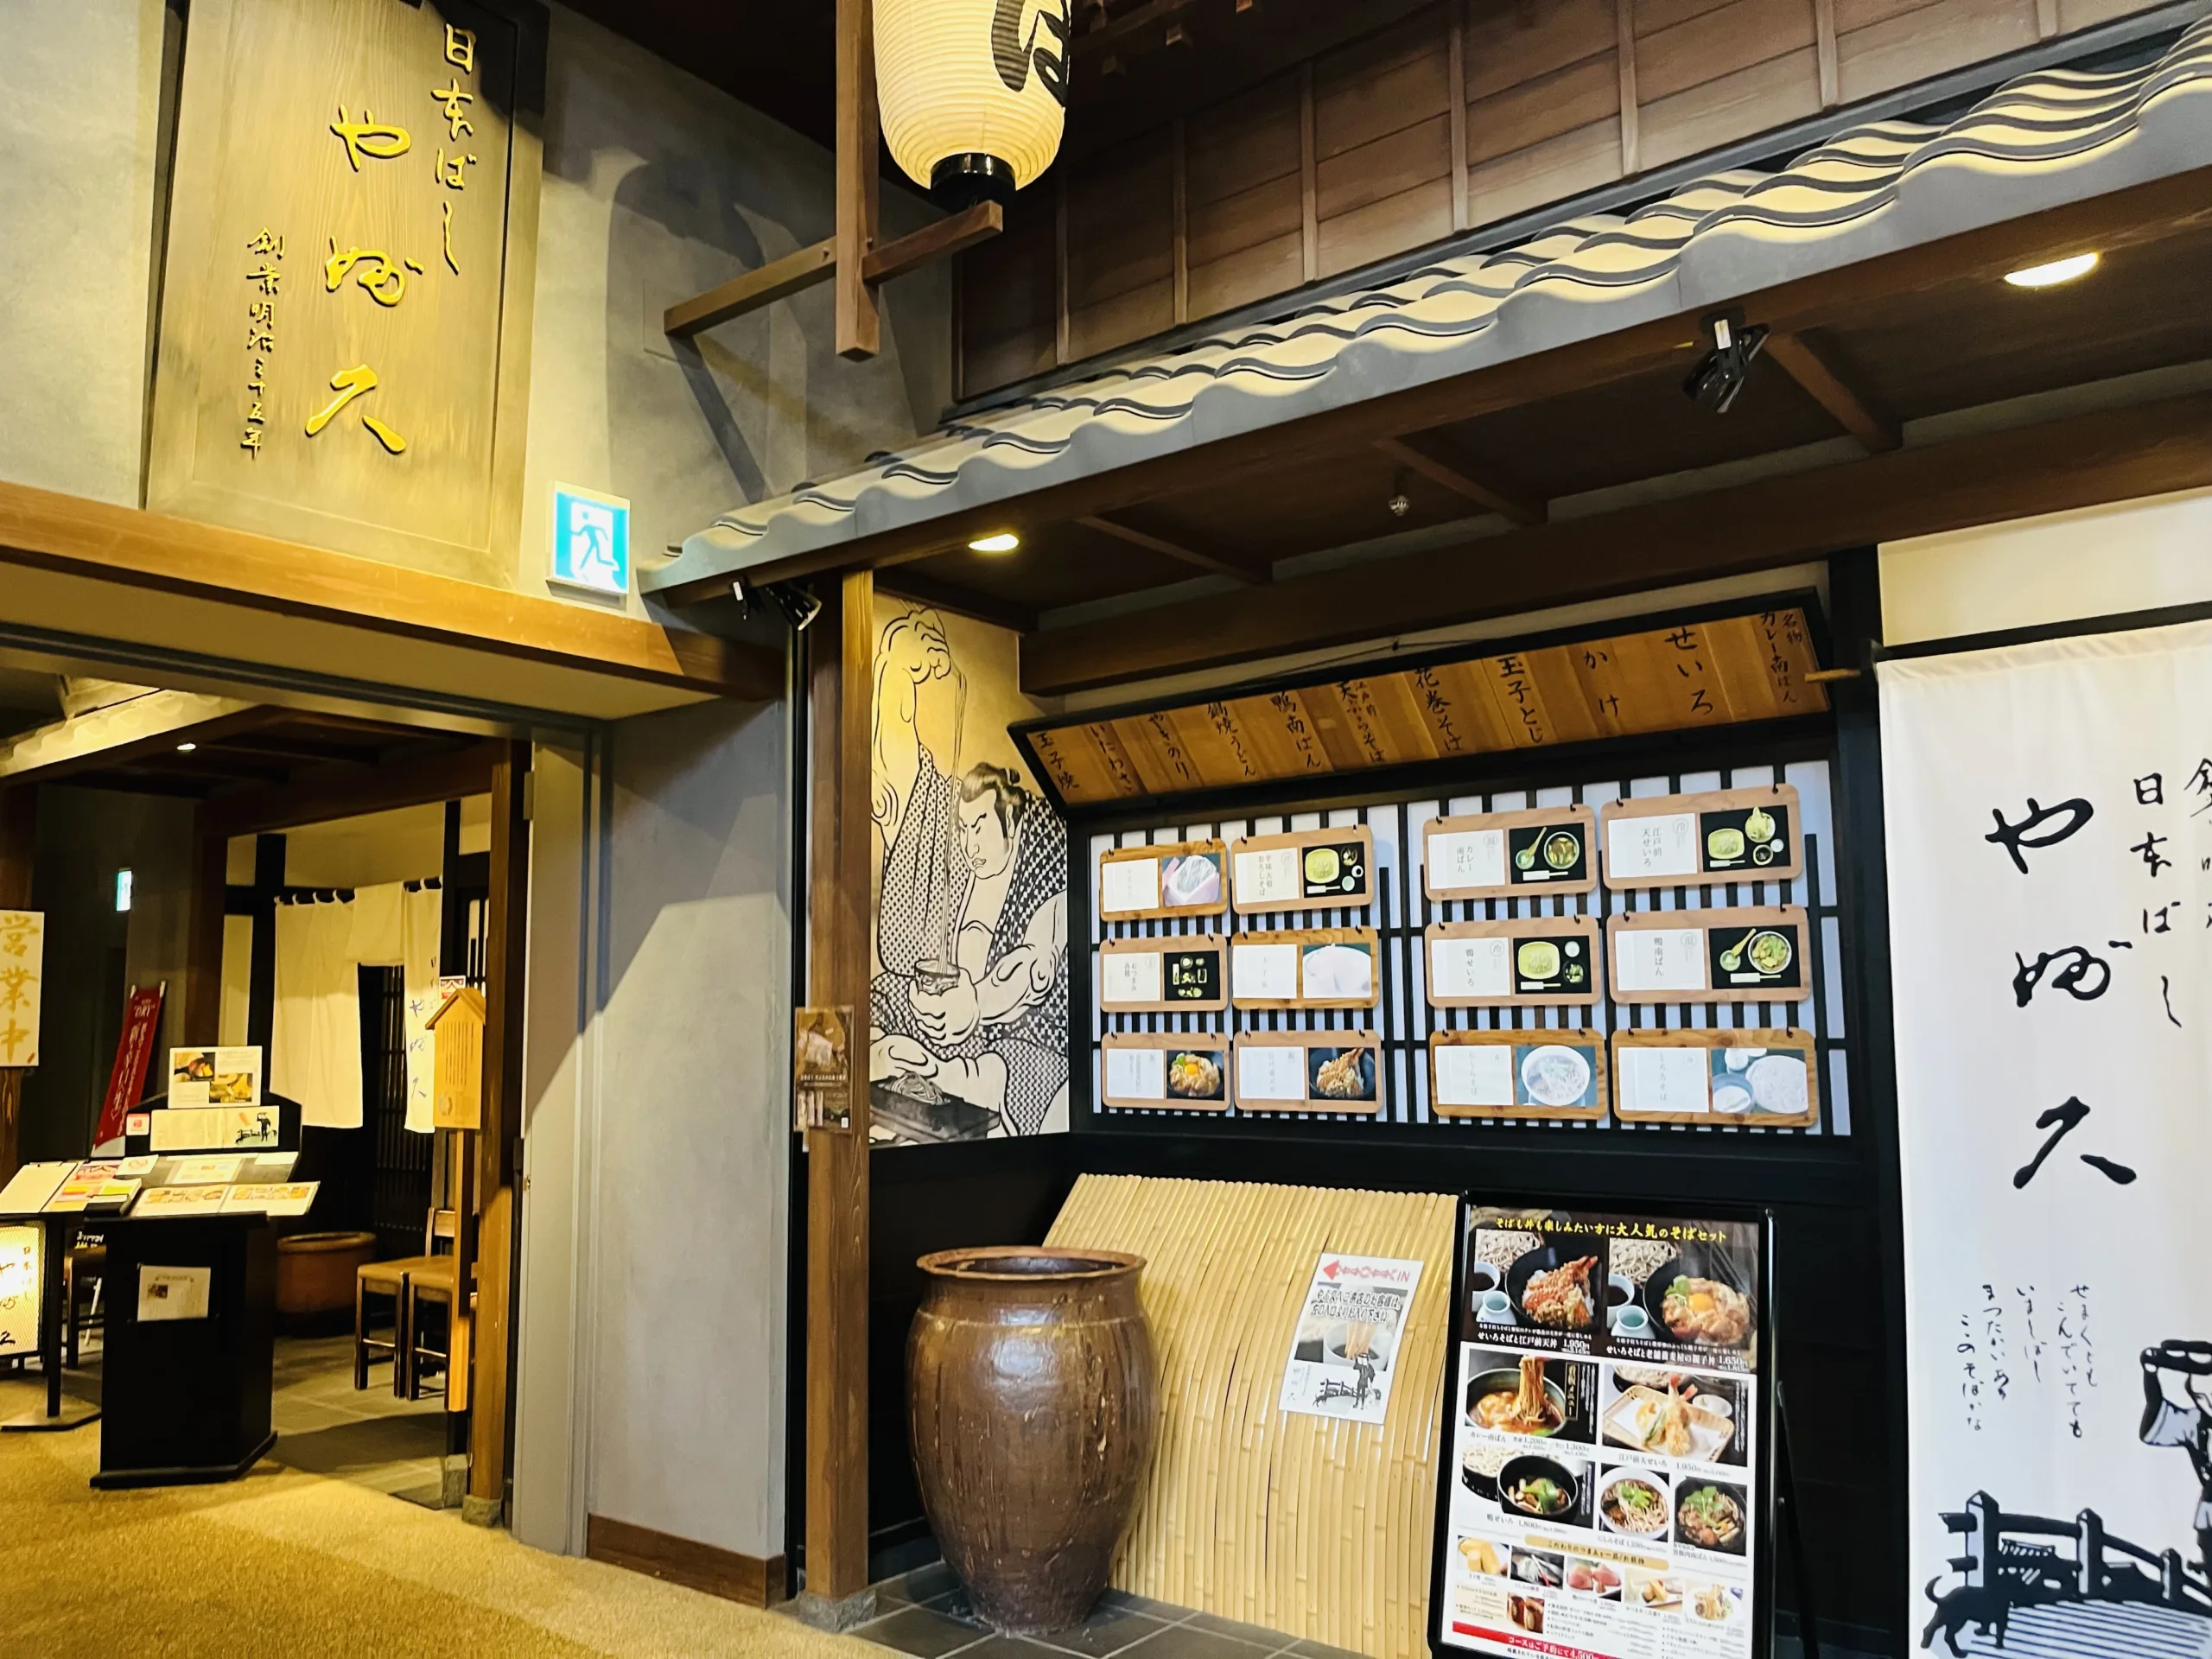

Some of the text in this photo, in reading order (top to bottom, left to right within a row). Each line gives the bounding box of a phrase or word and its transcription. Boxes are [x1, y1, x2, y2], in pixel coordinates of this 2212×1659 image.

[431, 22, 478, 276] 日本ばし
[240, 226, 285, 460] 創業明治三十五年
[1413, 666, 1462, 752] 花巻そば
[1496, 655, 1544, 743] 玉子とじ
[1583, 650, 1620, 718] かけ
[1665, 626, 1713, 715] せいろ
[1037, 731, 1080, 791] 玉子焼
[2130, 772, 2183, 1028] 日本ばし
[0, 914, 40, 1064] 営業中
[1397, 1271, 1410, 1283] IN
